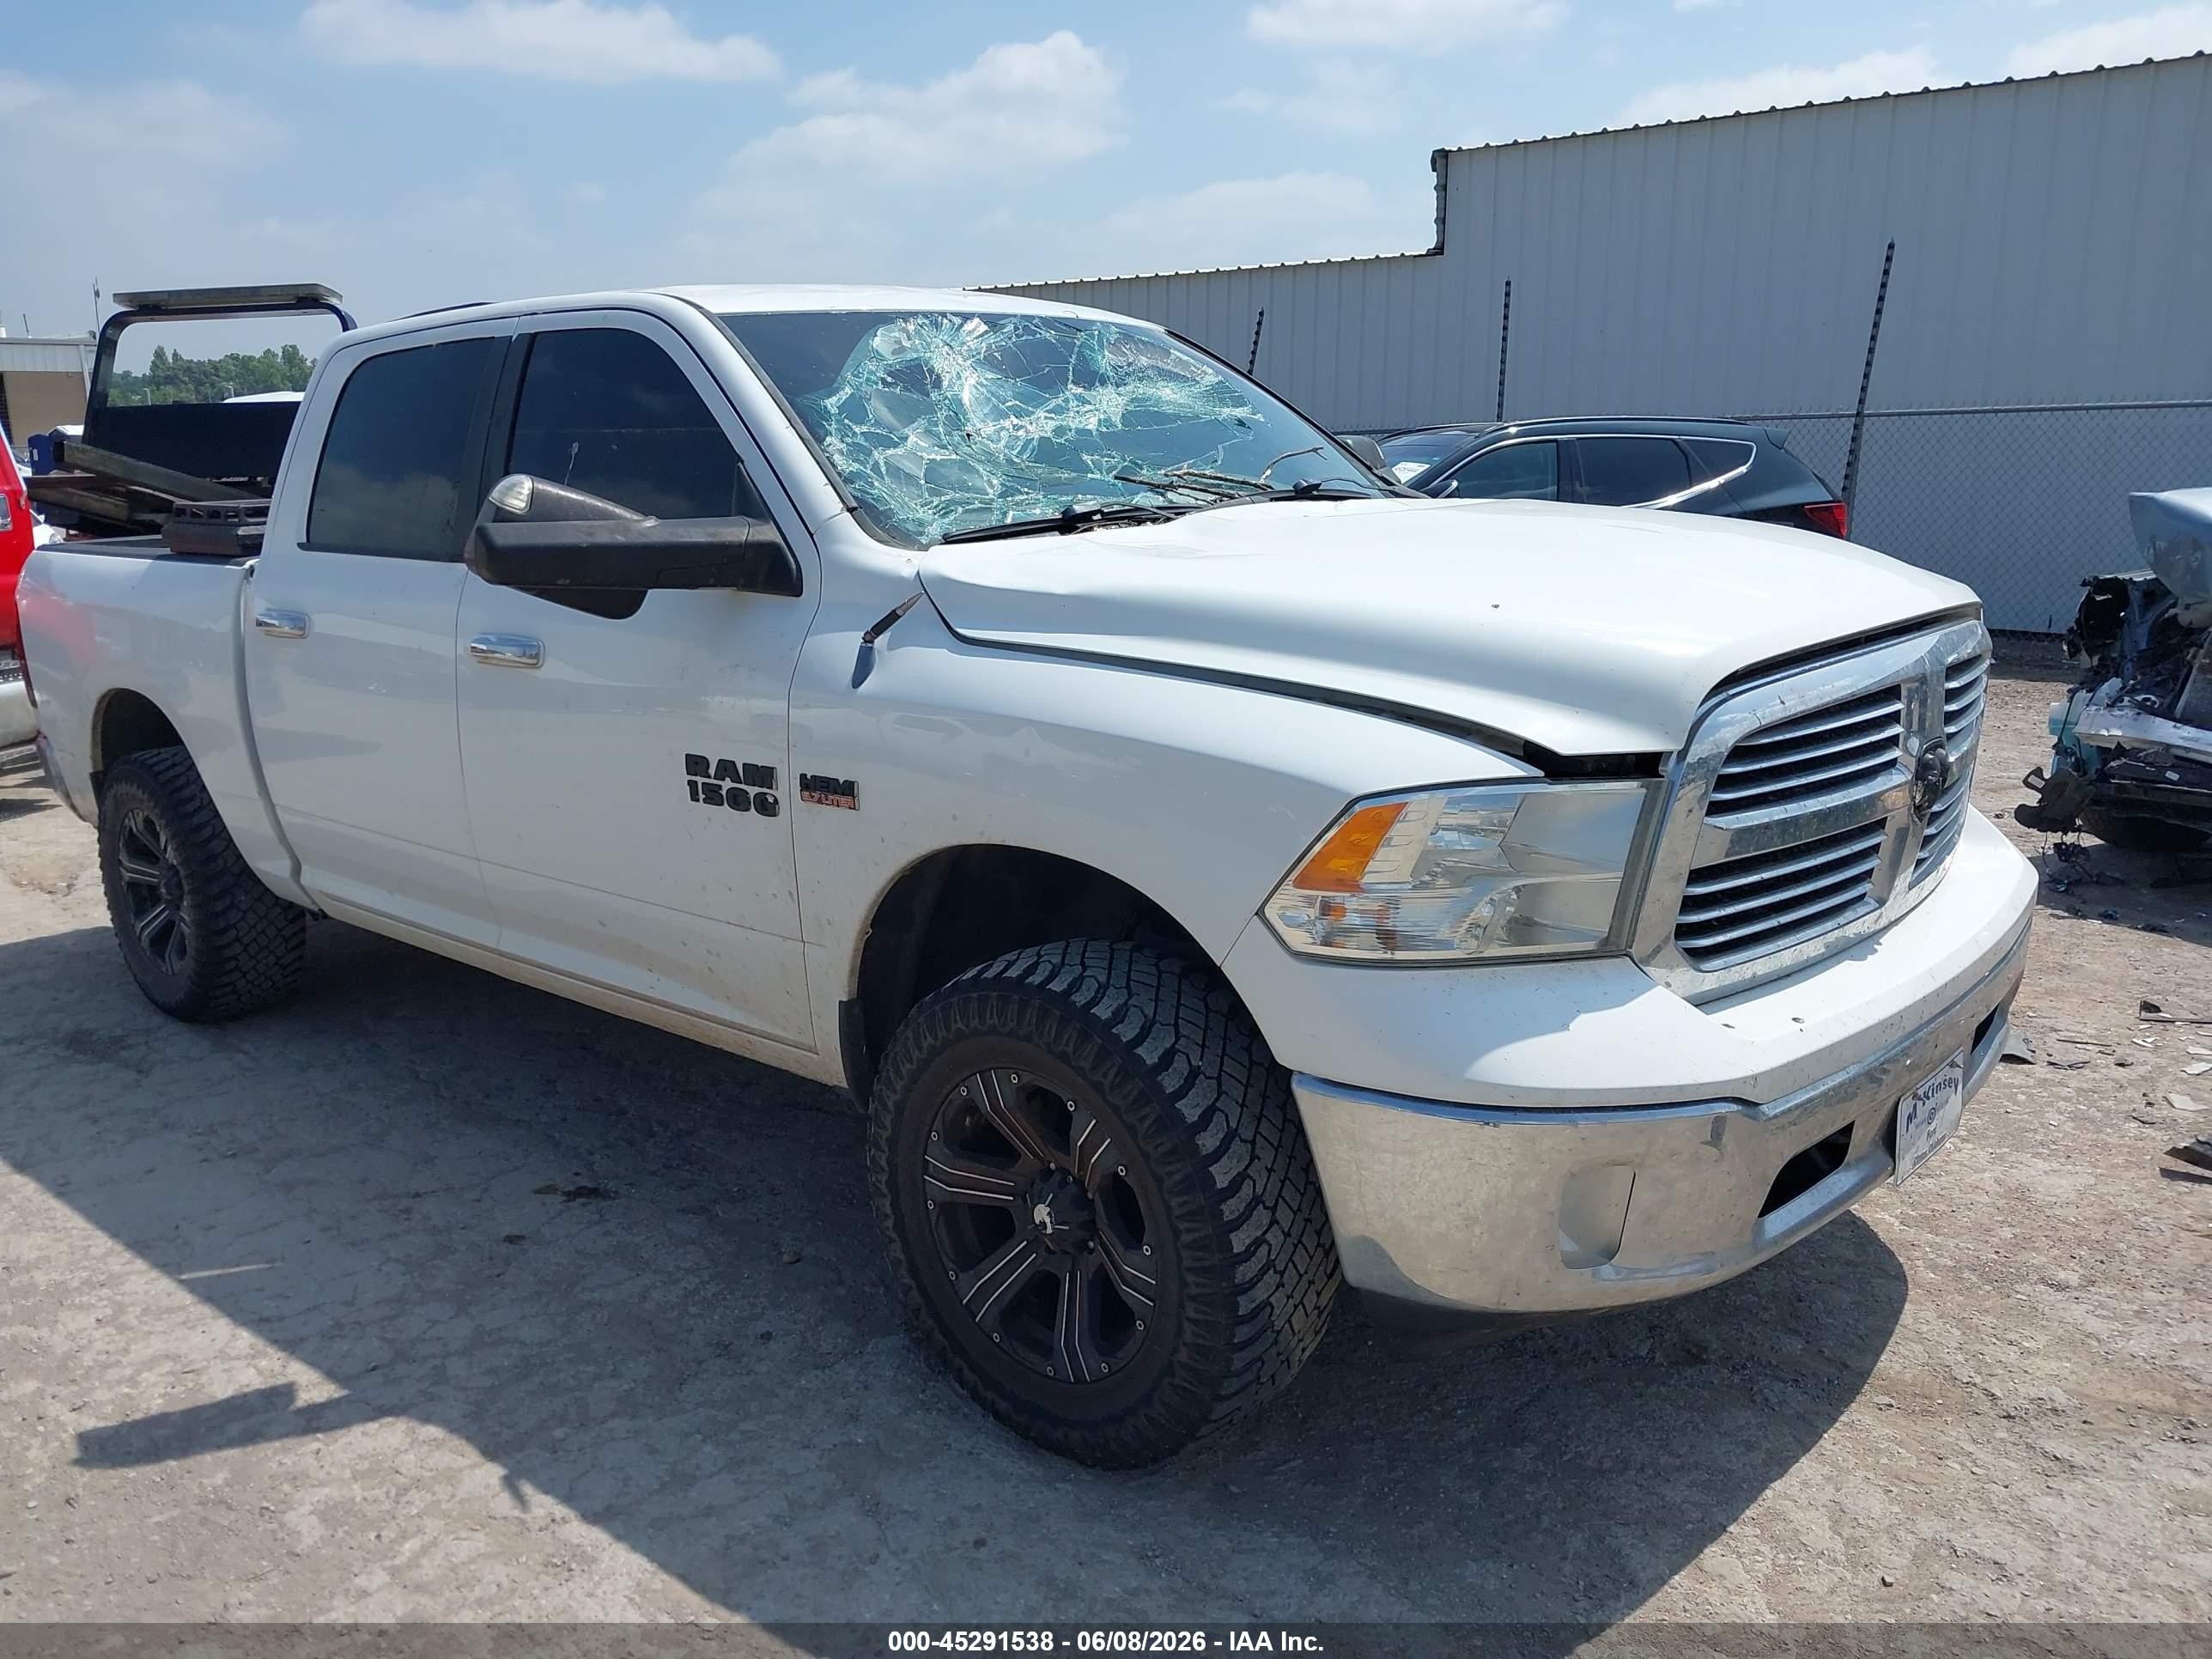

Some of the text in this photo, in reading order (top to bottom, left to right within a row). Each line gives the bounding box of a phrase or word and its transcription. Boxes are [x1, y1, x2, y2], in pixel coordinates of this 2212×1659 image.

[684, 753, 778, 790] RAM
[799, 773, 859, 798] HEMI
[687, 779, 781, 817] 1500
[801, 790, 854, 809] 5.7 LITER
[1905, 1075, 1960, 1134] MKinsey
